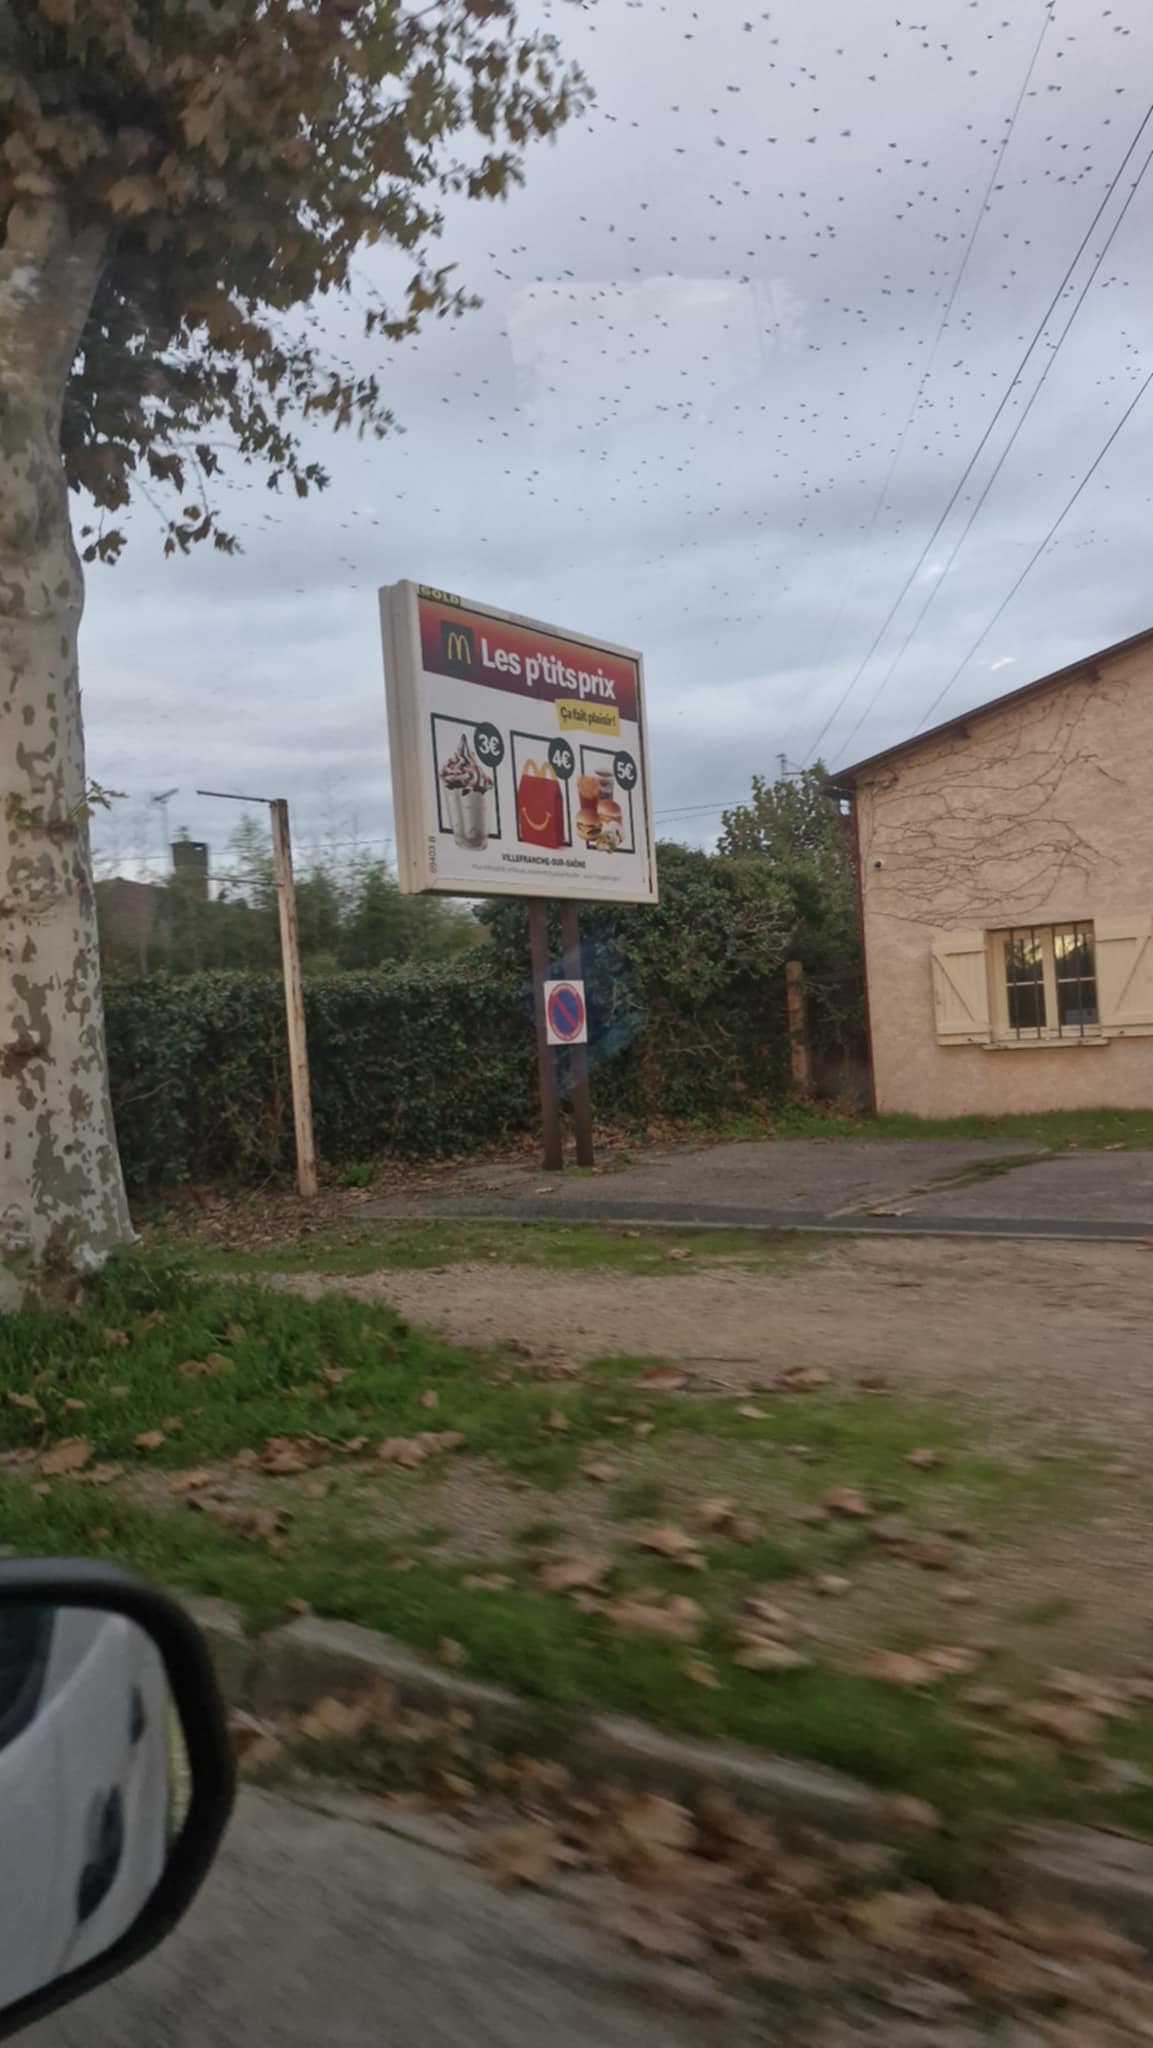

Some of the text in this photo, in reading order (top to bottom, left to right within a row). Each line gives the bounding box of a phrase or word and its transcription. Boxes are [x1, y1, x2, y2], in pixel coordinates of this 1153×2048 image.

[420, 585, 459, 605] GOLD
[480, 637, 521, 676] Les
[577, 667, 616, 700] prix
[560, 706, 572, 723] Ça
[573, 708, 587, 722] fait
[478, 733, 501, 757] 3€
[551, 748, 572, 769] 4€
[616, 760, 634, 781] 5€
